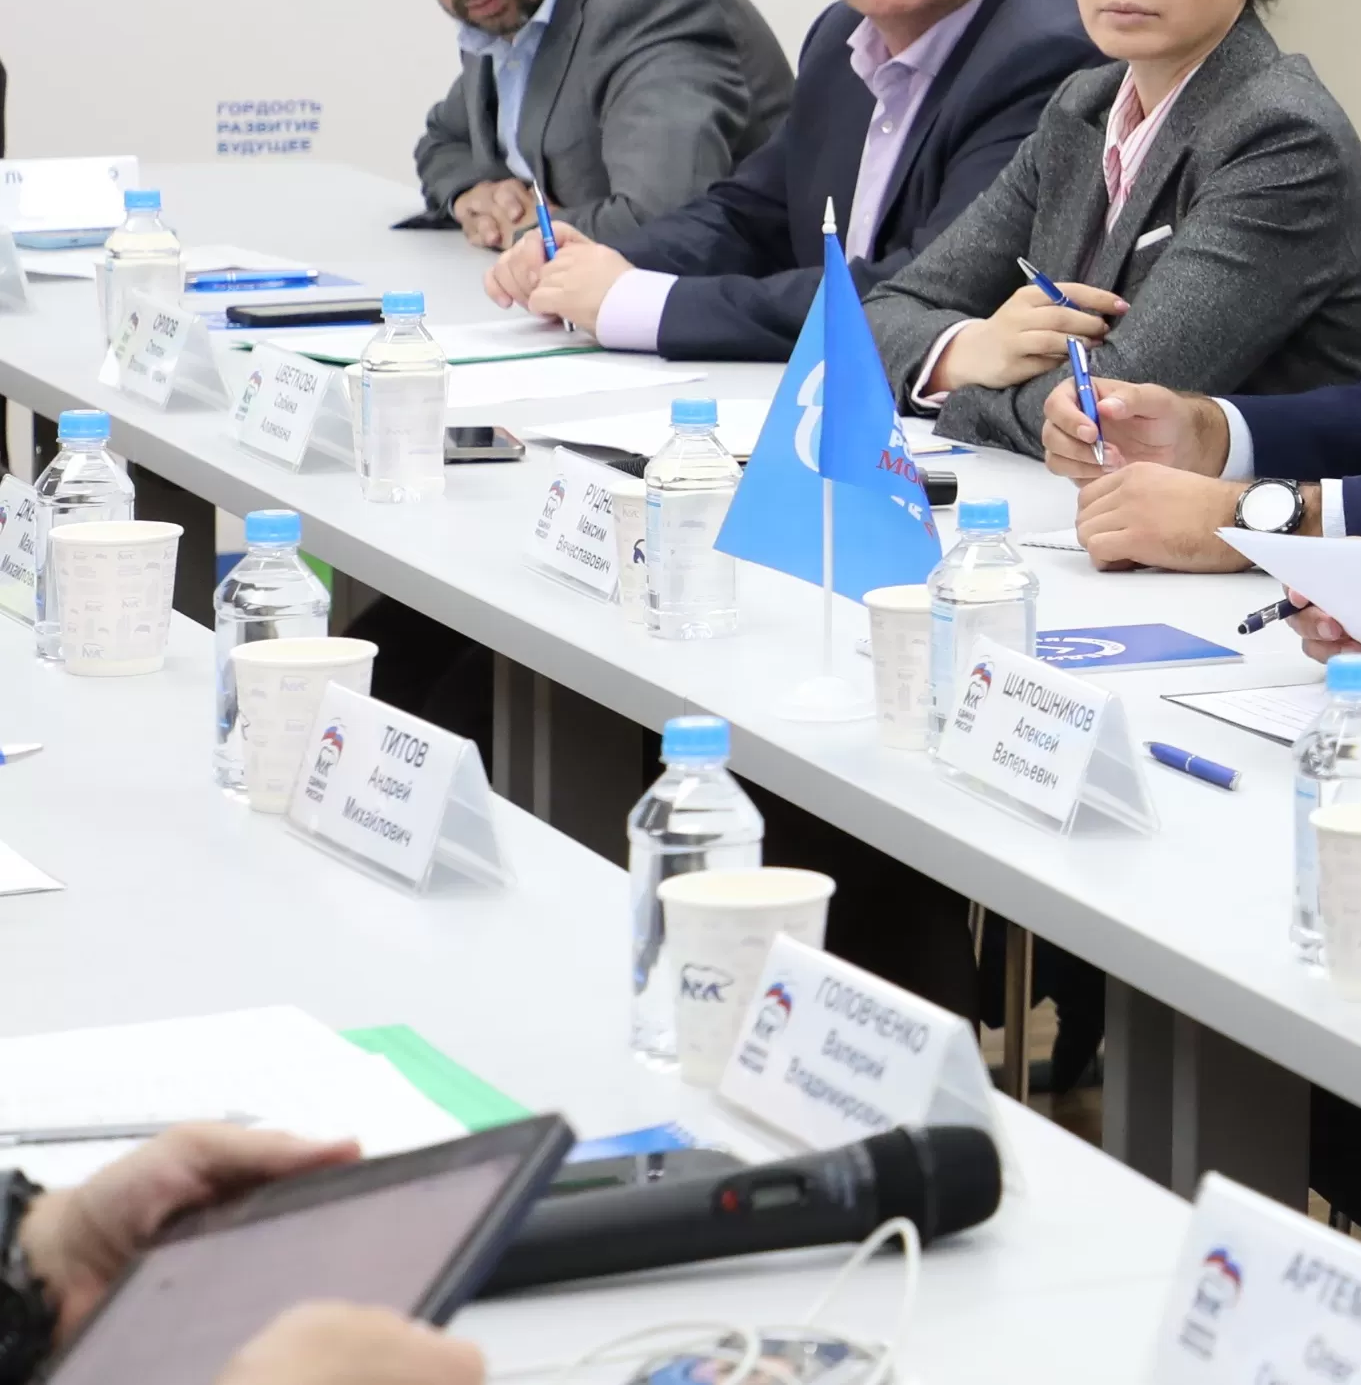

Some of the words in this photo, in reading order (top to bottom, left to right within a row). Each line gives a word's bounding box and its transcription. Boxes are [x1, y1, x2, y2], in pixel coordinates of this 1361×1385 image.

[577, 514, 608, 543] Максим
[556, 534, 612, 575] Вячеславович
[1002, 671, 1097, 733] ШАПОШНИКОВ
[378, 724, 429, 769] ТИТОВ
[1013, 716, 1061, 753] Алексей
[367, 765, 413, 804] Андрей
[992, 741, 1060, 790] Валерьевич
[341, 795, 413, 847] Михайлович
[814, 975, 931, 1056] ГОЛОВЧЕНКО
